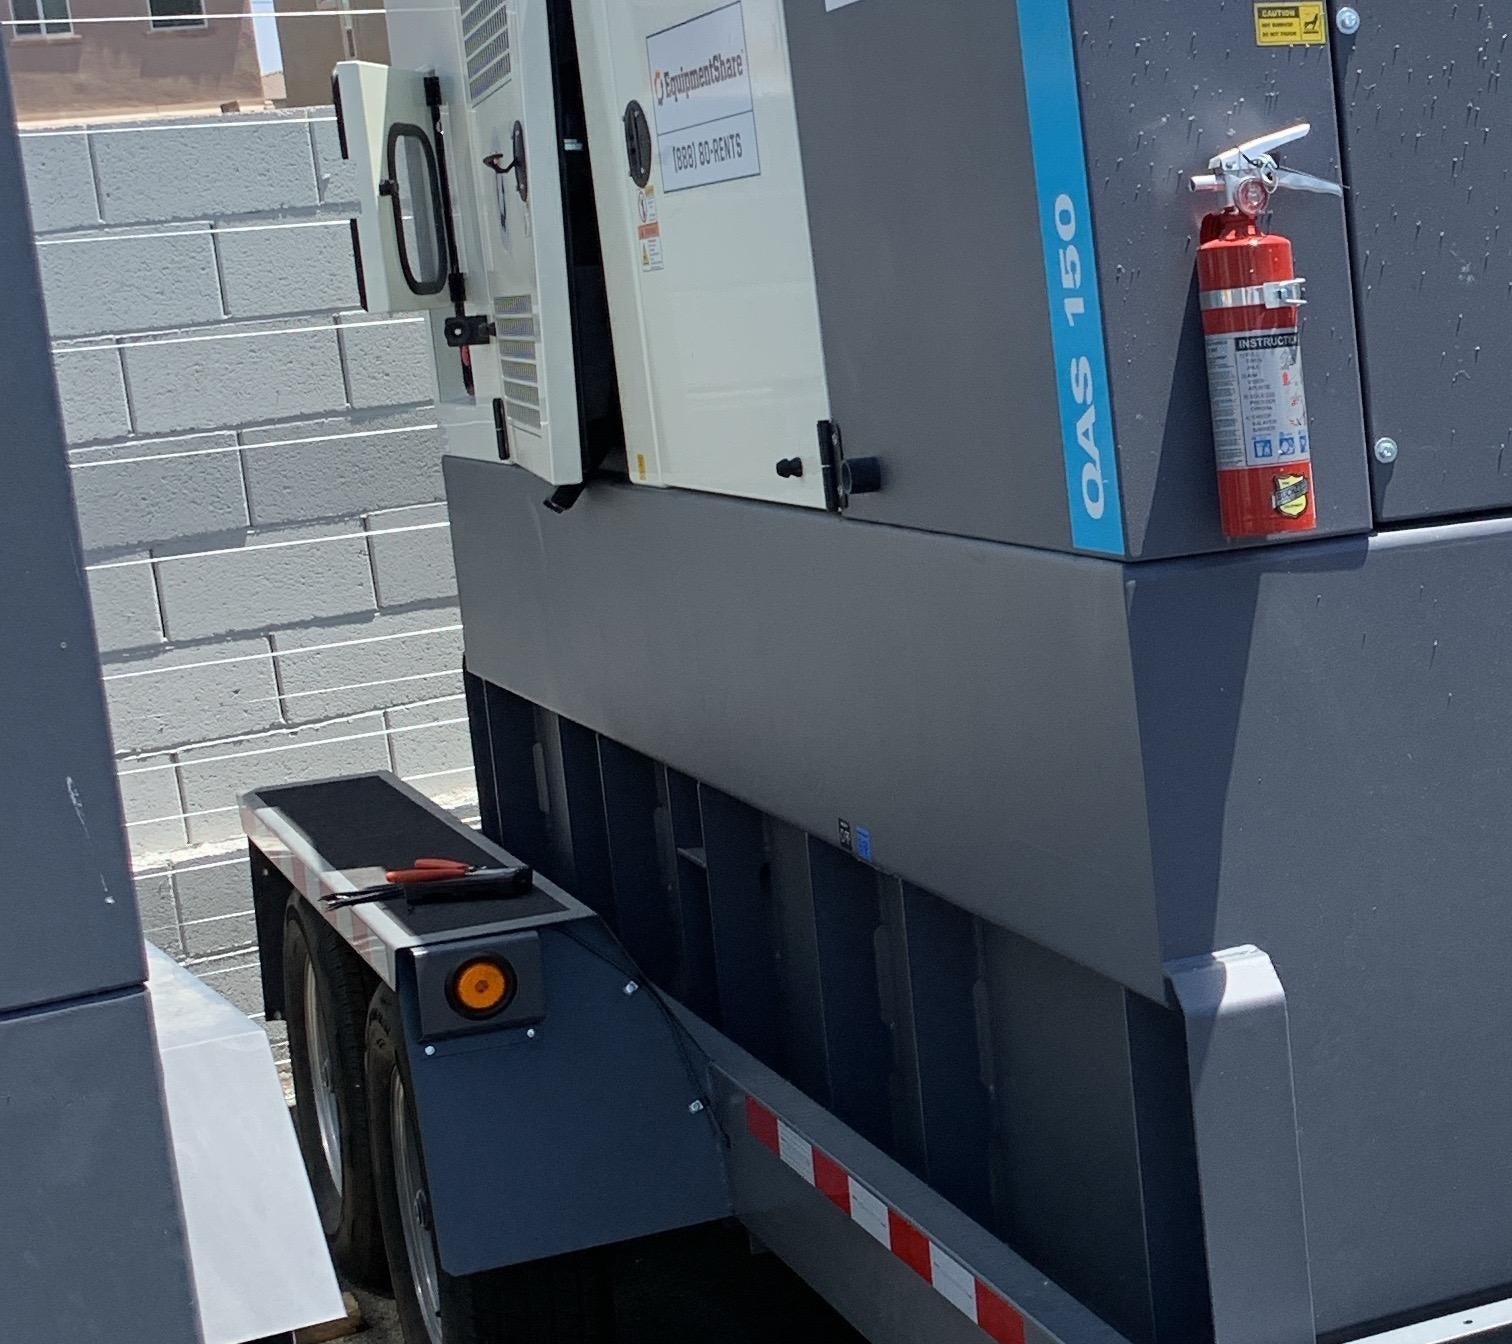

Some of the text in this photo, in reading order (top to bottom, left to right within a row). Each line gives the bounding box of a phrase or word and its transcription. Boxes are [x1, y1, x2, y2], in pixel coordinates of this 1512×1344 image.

[663, 53, 744, 103] EquipmentShare
[672, 133, 743, 173] (888) 80-RENTS
[1054, 193, 1106, 520] QAS 150
